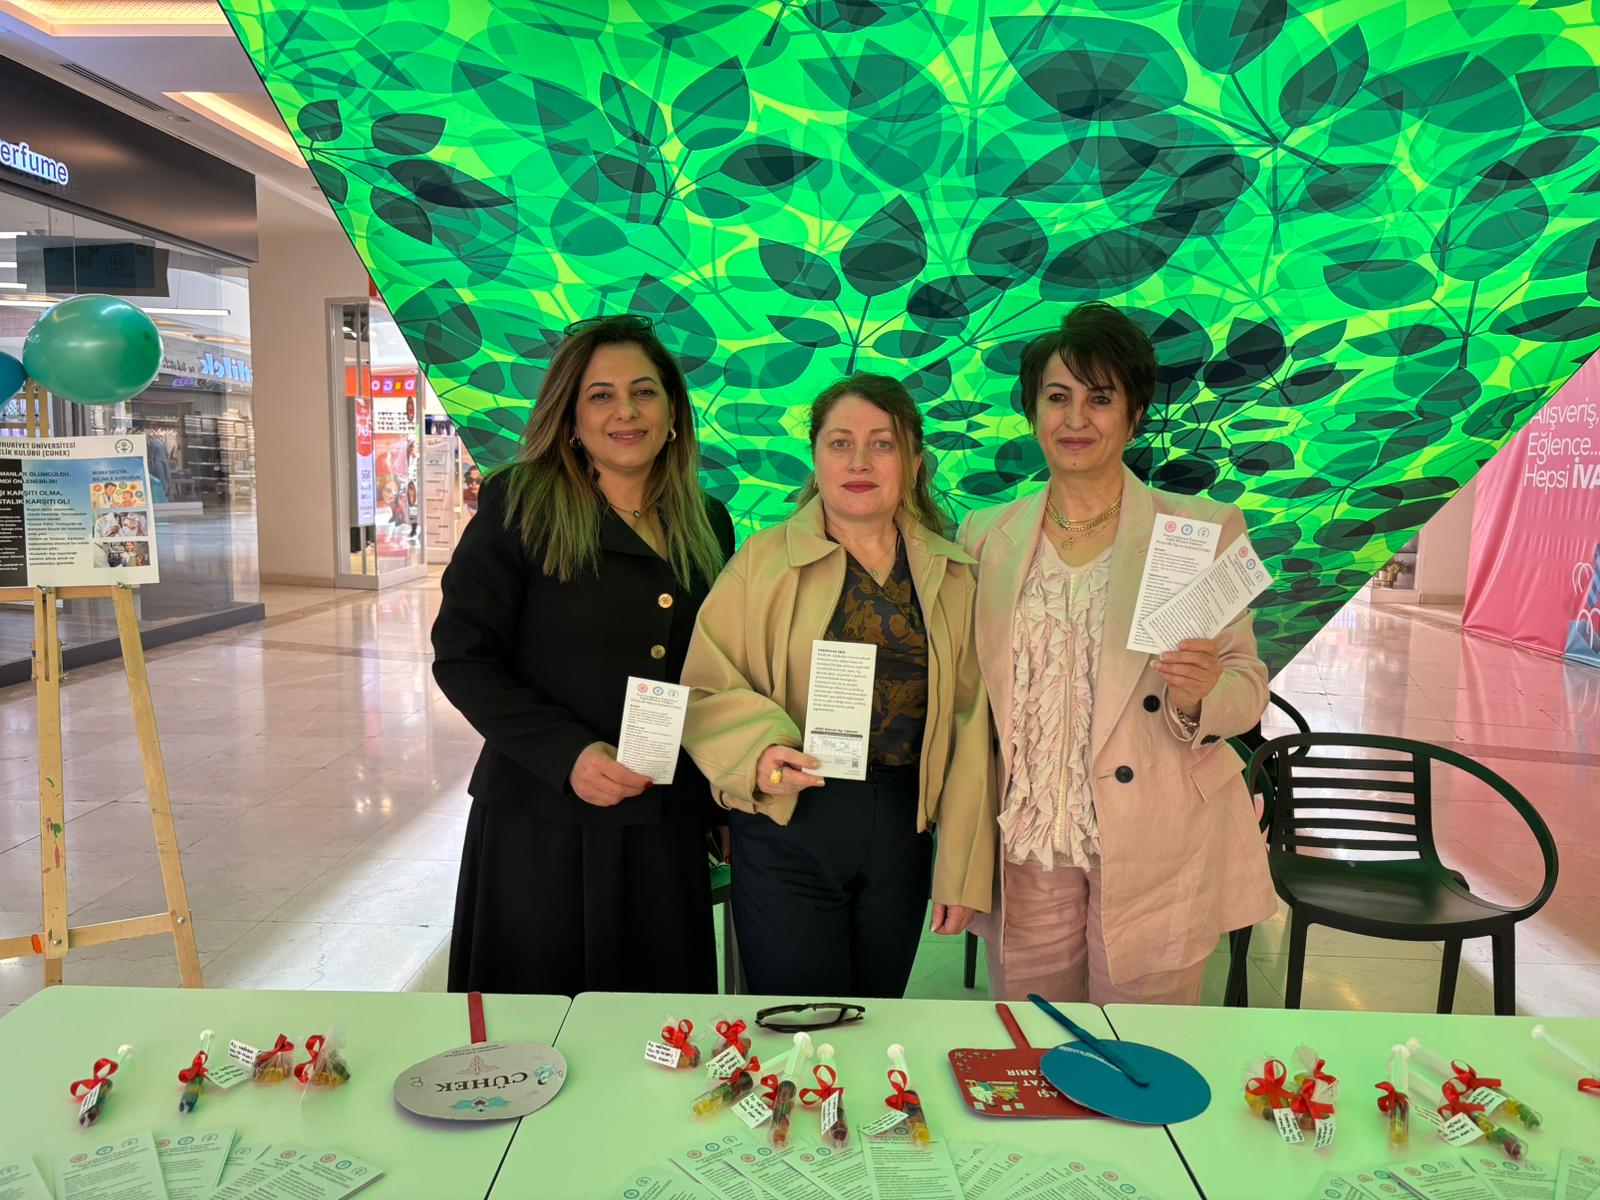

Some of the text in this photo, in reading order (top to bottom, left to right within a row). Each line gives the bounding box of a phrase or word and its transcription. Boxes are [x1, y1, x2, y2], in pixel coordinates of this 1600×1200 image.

[0, 141, 68, 184] erfume
[0, 441, 29, 449] HURİYET
[1523, 464, 1569, 495] Hepsi
[7, 489, 37, 497] KARŞITI
[26, 498, 55, 506] KARŞITI
[435, 1072, 528, 1092] CÜHEK
[1023, 1079, 1049, 1087] YAT
